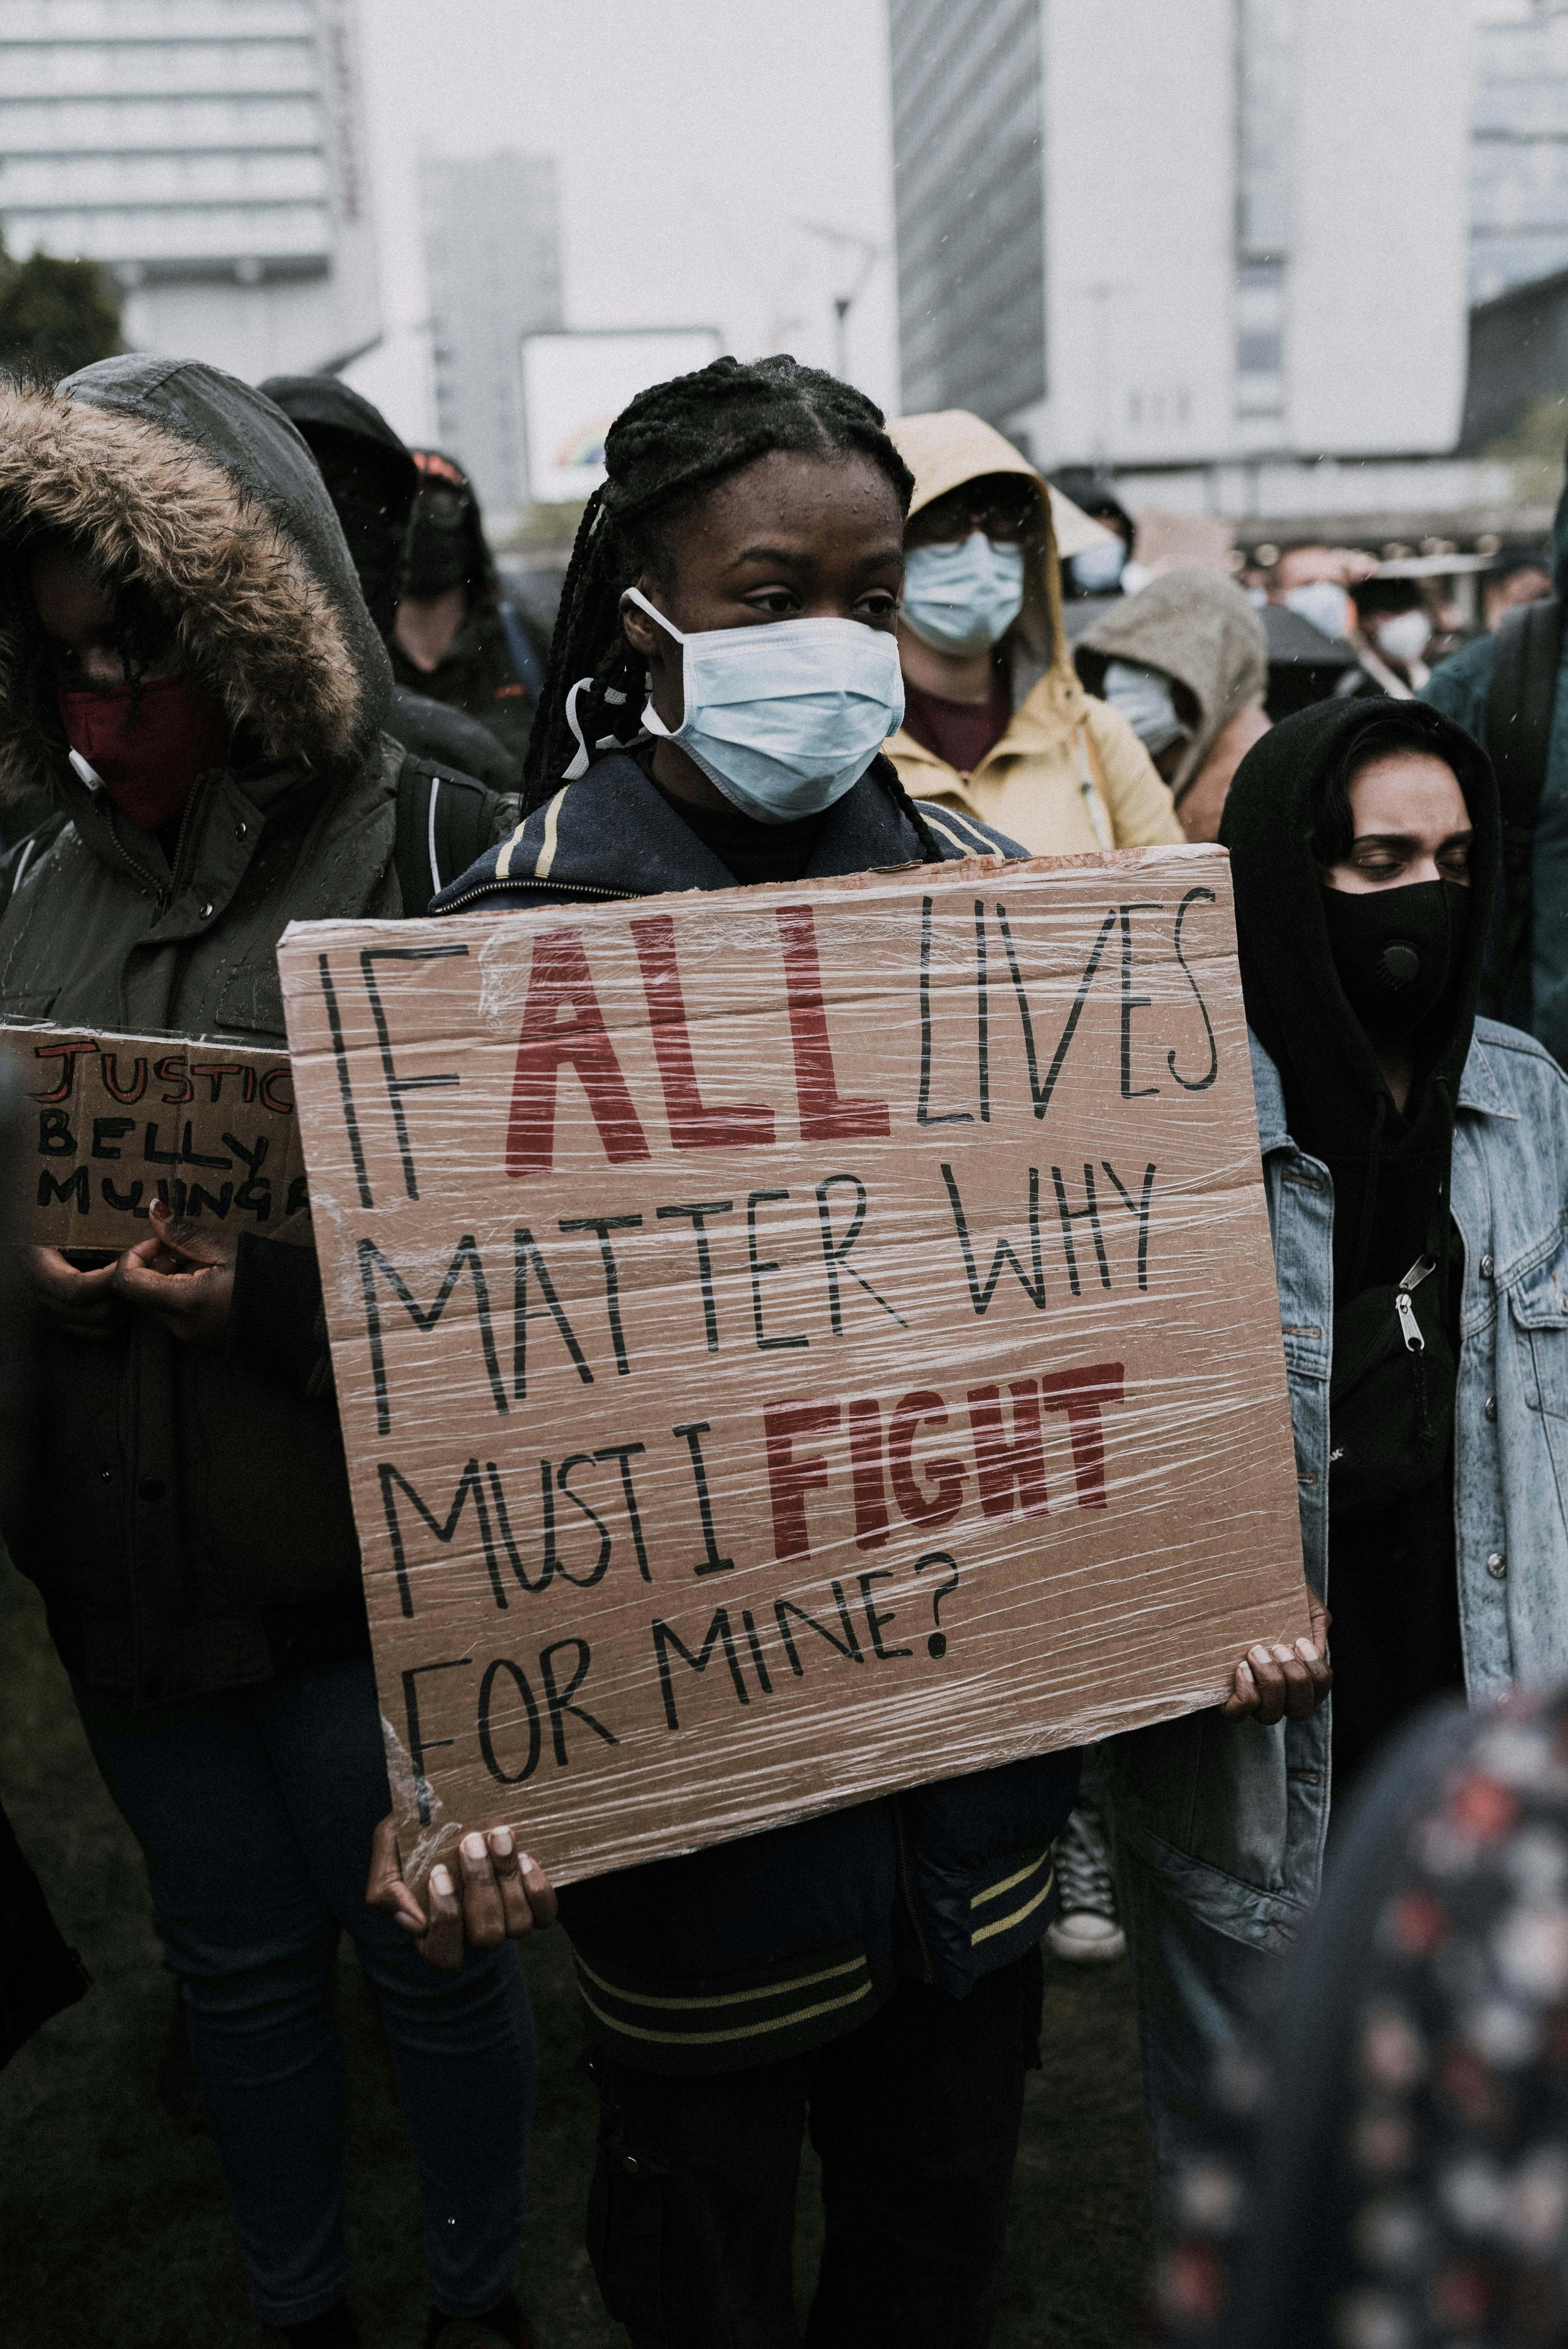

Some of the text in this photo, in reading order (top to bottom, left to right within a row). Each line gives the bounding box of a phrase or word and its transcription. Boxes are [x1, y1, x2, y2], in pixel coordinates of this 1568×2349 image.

[28, 1039, 294, 1114] JUSTIC
[38, 1108, 269, 1178] BELLY
[319, 887, 1218, 1209] IF ALL LIVES
[357, 1161, 1156, 1435] MATTER WHY
[378, 1362, 1125, 1618] MUST I FIGHT
[401, 1552, 959, 1827] FOR MINE?
